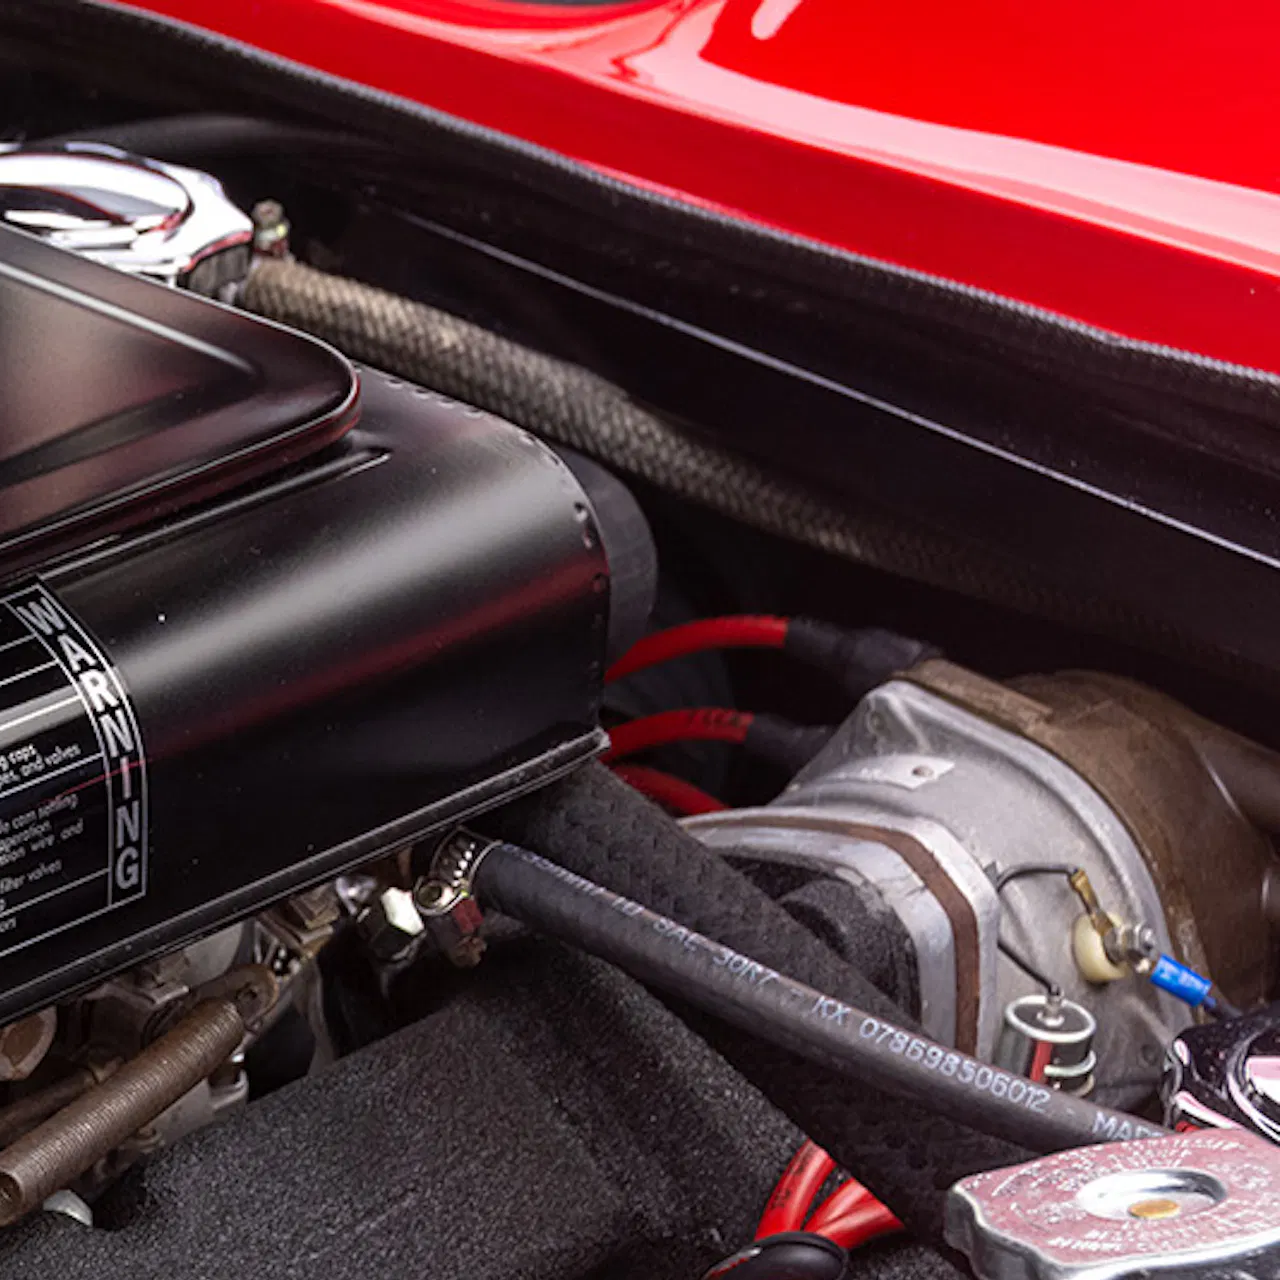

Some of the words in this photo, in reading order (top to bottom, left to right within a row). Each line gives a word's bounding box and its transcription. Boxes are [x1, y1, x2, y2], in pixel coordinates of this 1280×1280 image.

[16, 595, 141, 888] WARNING
[17, 752, 45, 776] and
[811, 995, 852, 1026] KX
